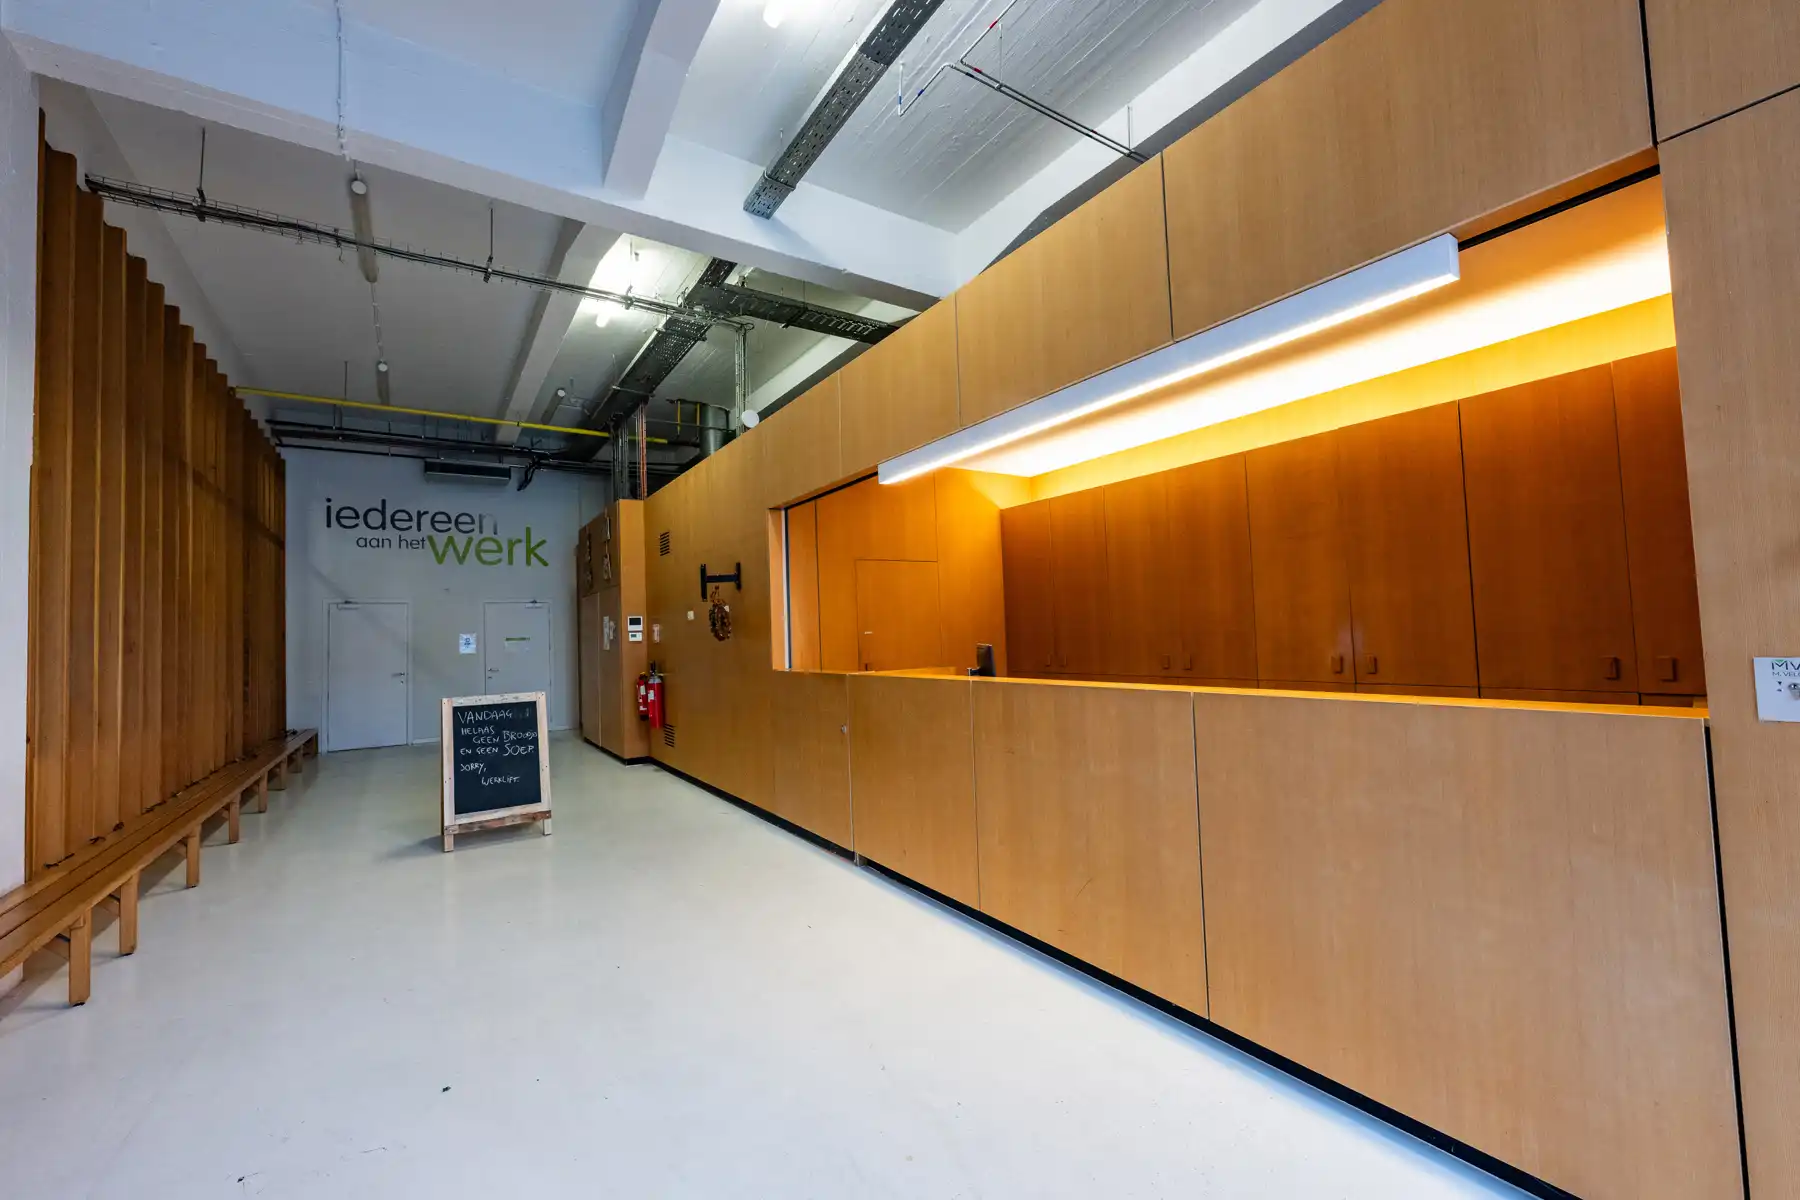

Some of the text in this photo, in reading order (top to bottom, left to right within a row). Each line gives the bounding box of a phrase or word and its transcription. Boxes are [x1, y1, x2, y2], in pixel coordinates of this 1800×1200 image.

[326, 498, 498, 535] iedereen
[356, 526, 549, 567] aan het werk
[458, 709, 513, 724] VANDAAG
[461, 725, 495, 735] HELAAS
[472, 736, 500, 744] GEEN
[460, 747, 472, 755] EN
[476, 746, 499, 755] GEEN
